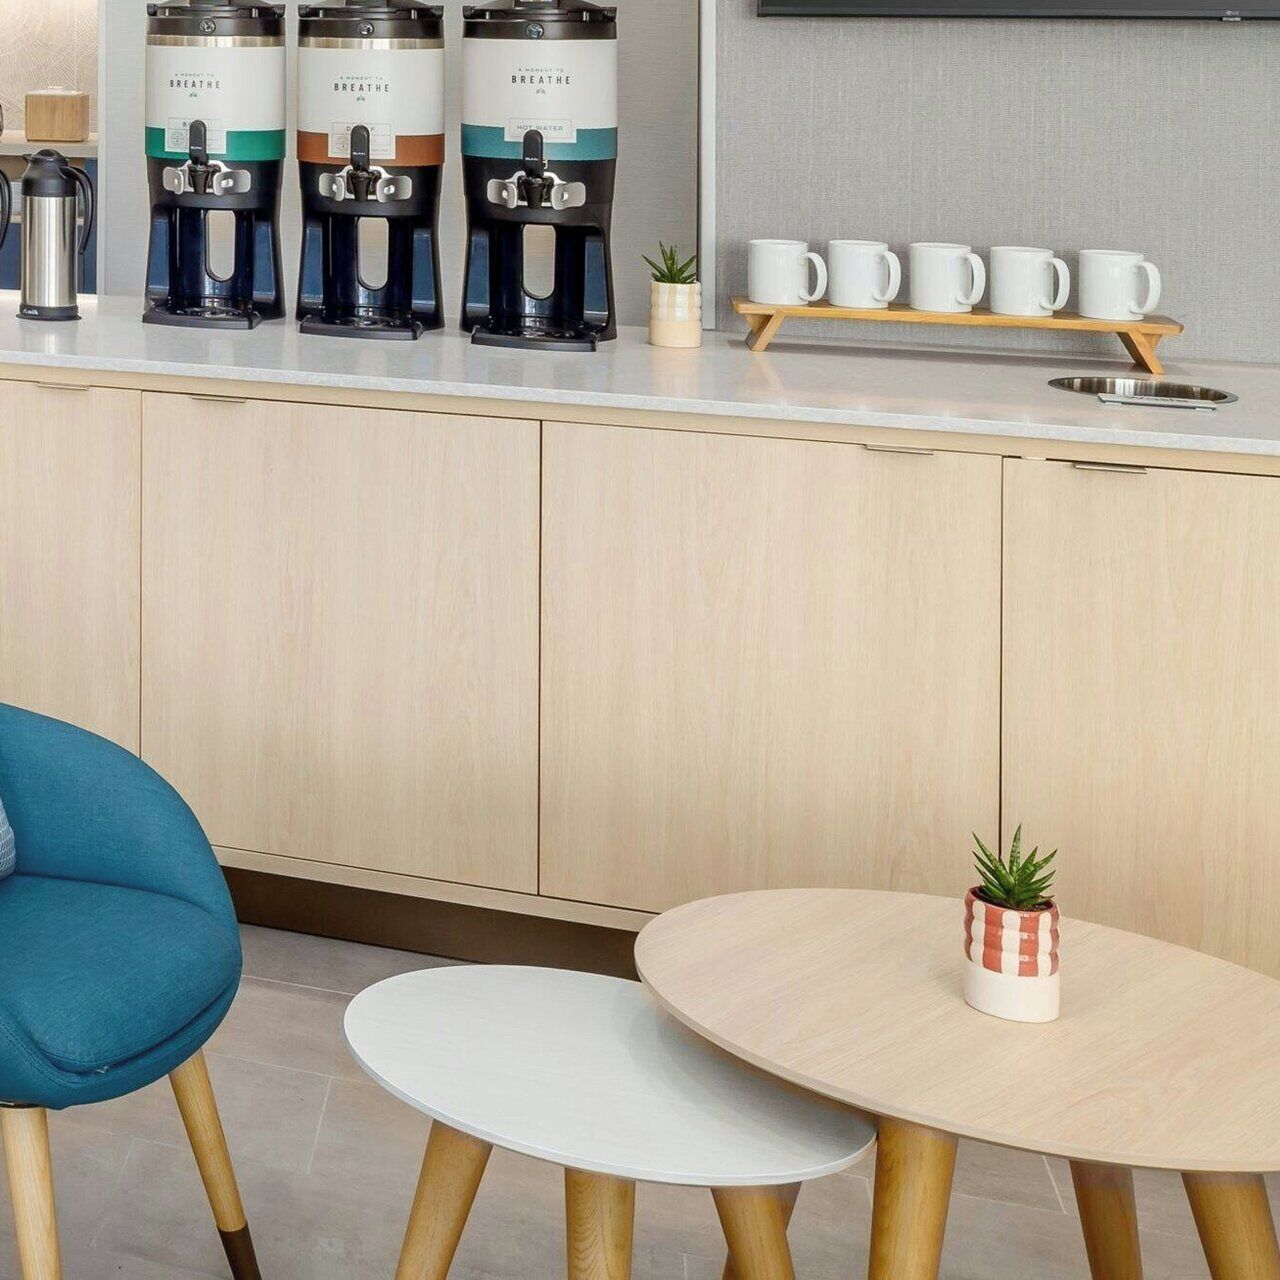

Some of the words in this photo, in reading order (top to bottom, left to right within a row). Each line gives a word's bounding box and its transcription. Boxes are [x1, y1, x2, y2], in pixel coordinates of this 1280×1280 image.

[169, 79, 220, 89] BREATHE
[511, 74, 571, 85] BREATHE
[333, 82, 390, 93] BREATHE
